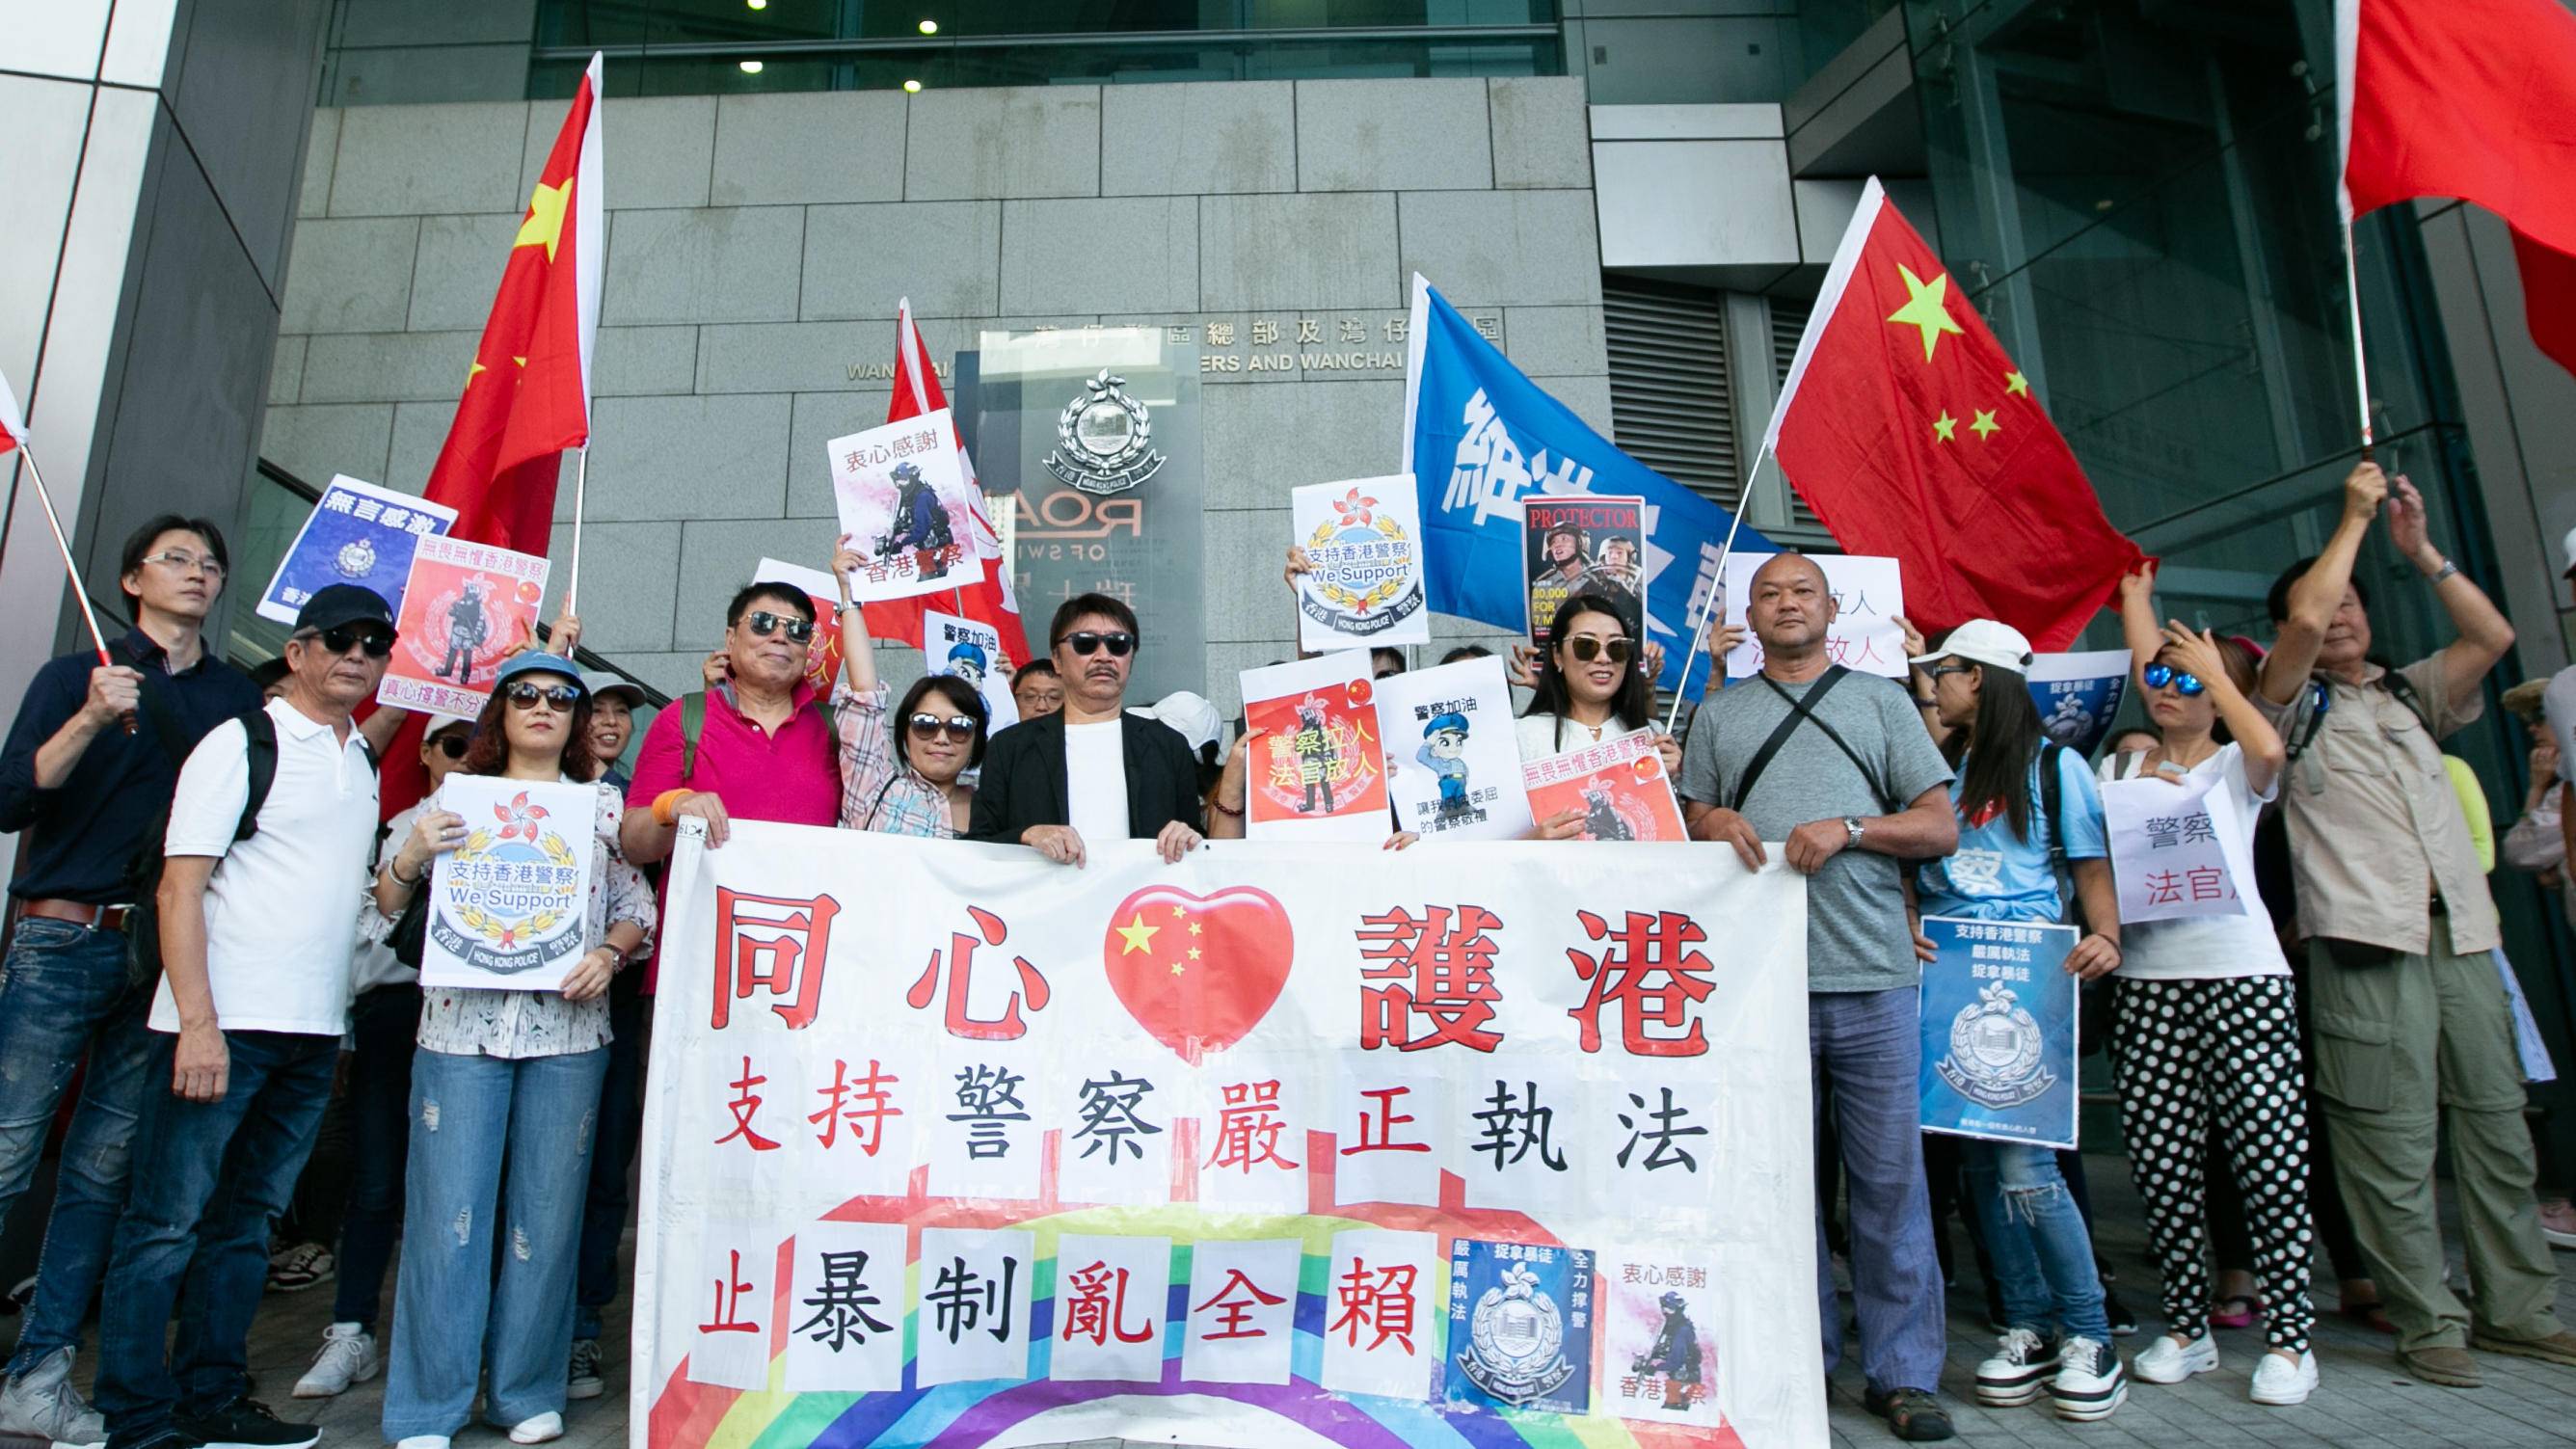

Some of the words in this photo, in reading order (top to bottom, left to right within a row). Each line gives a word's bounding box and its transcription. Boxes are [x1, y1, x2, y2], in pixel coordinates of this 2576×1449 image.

[847, 361, 949, 380] WANAI
[1248, 354, 1294, 371] AND
[1301, 352, 1403, 369] WANCHAI
[844, 428, 939, 473] 衷心感謝
[324, 490, 437, 535] 無言感激
[1530, 508, 1639, 529] PROTECTOR
[422, 539, 547, 579] 無畏無懼香港警察
[865, 543, 964, 584] 香港警察
[1309, 542, 1409, 563] 支持香港警察
[1311, 569, 1336, 582] We
[1341, 563, 1409, 584] Support
[1305, 602, 1328, 623] 香港
[1533, 601, 1555, 612] FOR
[1534, 615, 1540, 625] 7
[1543, 614, 1555, 626] M
[1338, 619, 1355, 631] HONG
[1355, 621, 1370, 631] KONG
[1370, 615, 1390, 630] POLICE
[944, 623, 997, 652] 警察加油
[386, 679, 489, 713] 真心撐警不分
[1414, 696, 1478, 721] 警察加油
[1268, 718, 1375, 760] 警察拉人
[1269, 751, 1379, 787] 法官放人
[1525, 735, 1650, 786] 無畏無懼香港警察
[2146, 812, 2217, 849] 警察
[451, 861, 576, 885] 支持香港警察
[2144, 865, 2240, 906] 法官
[449, 888, 481, 904] We
[489, 889, 571, 910] Support
[434, 925, 464, 953] 香港
[473, 949, 495, 965] HONG
[494, 952, 514, 967] KONG
[514, 951, 539, 967] POLICE
[1494, 1244, 1553, 1264] 捉拿暴徒
[1623, 1263, 1707, 1289] 衷心感謝
[1620, 1376, 1706, 1405] 香港警察
